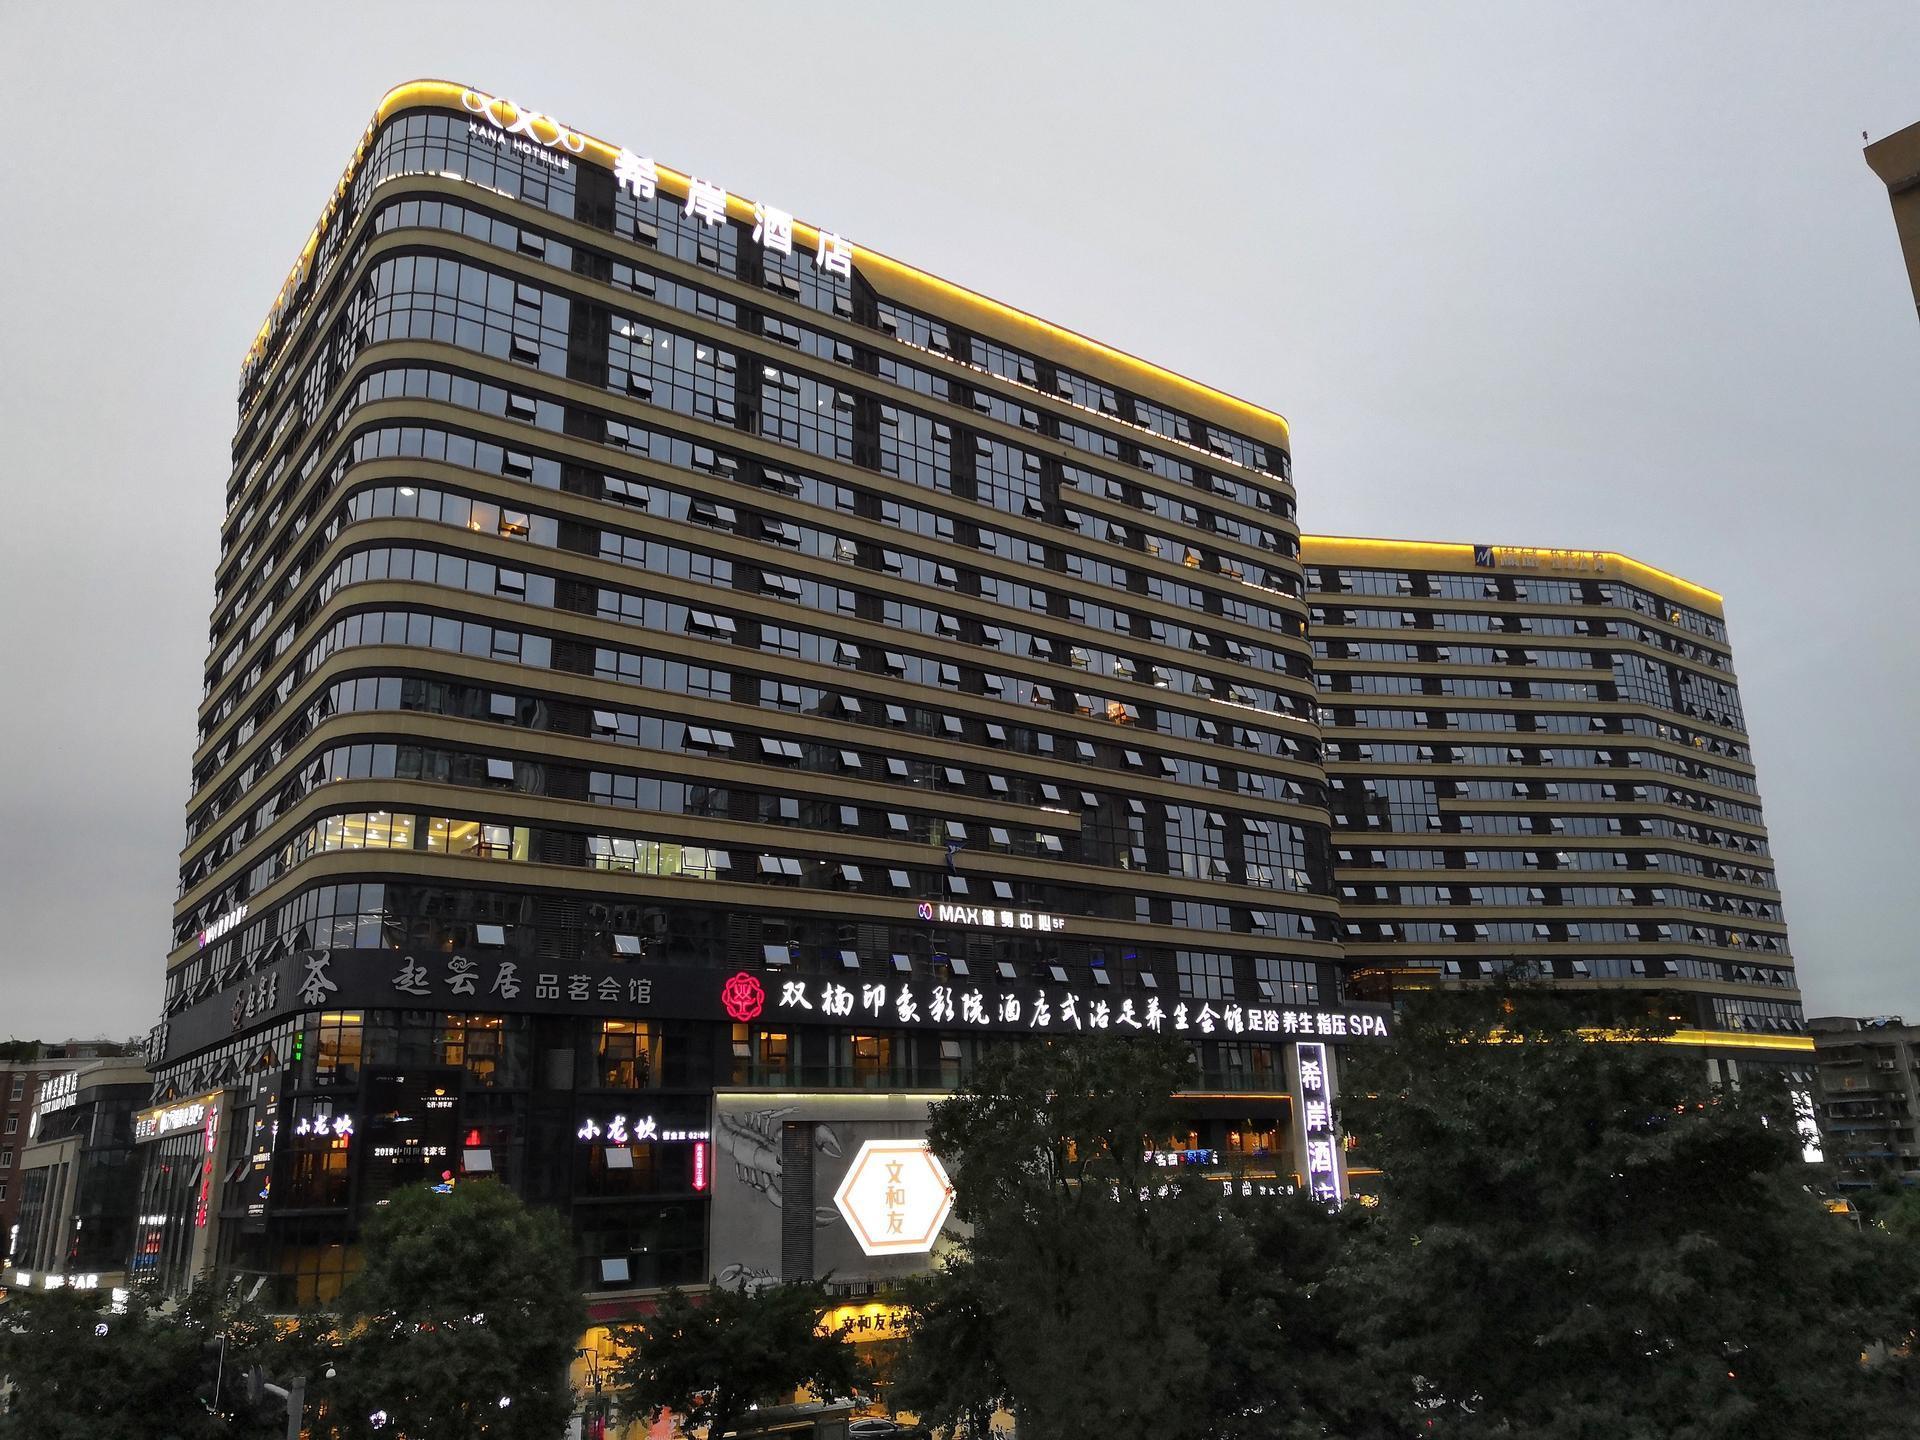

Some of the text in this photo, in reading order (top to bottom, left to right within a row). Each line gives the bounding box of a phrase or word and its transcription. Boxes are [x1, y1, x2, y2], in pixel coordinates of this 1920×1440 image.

[468, 119, 570, 170] XANA HOTELLE
[613, 147, 852, 279] 希岸酒店
[296, 950, 338, 1005] 茶
[535, 972, 653, 1004] 品茗会馆
[577, 1114, 658, 1142] 小龙坎
[885, 1159, 905, 1235] 文和友
